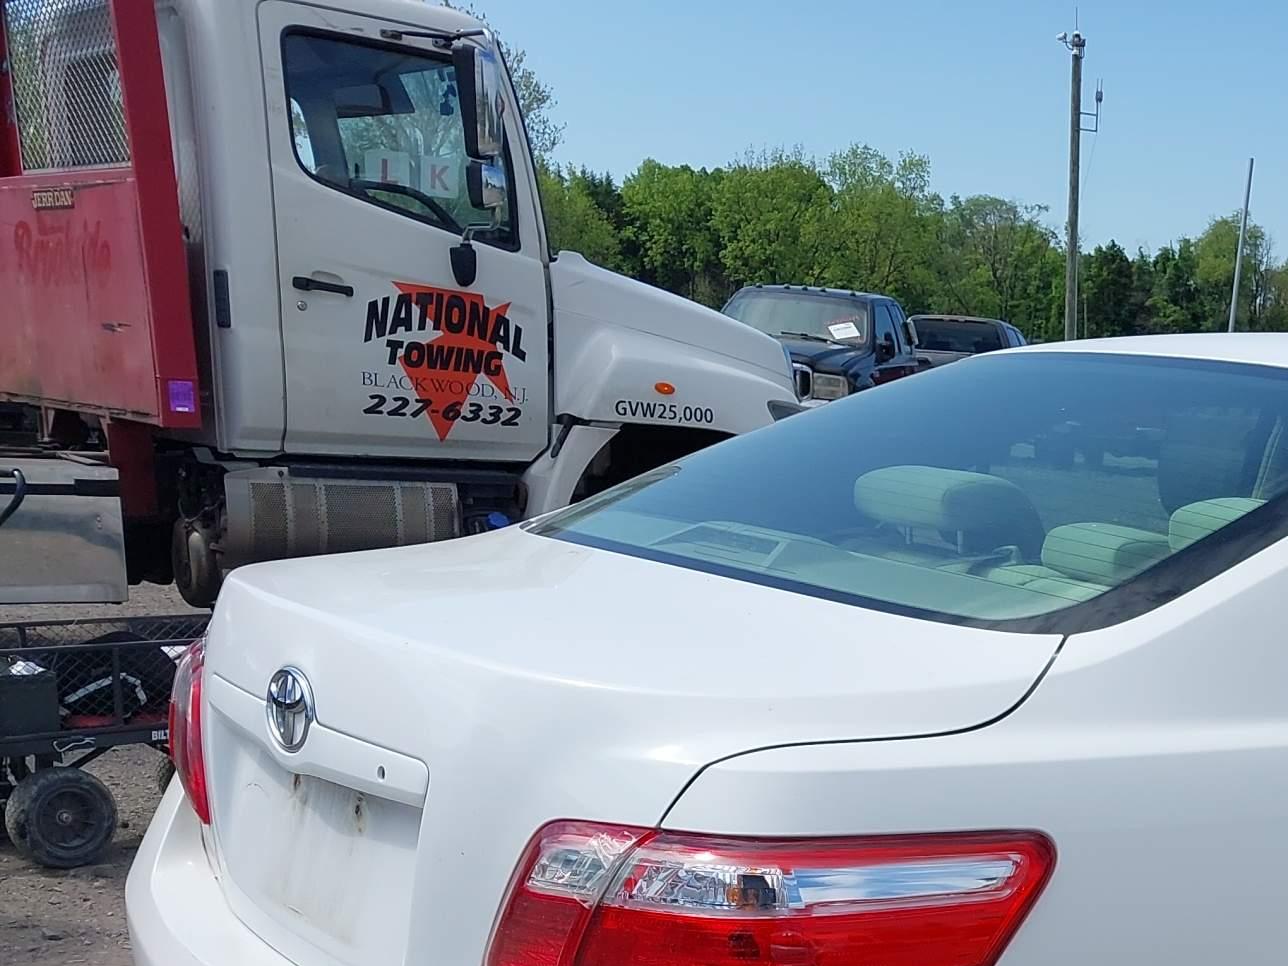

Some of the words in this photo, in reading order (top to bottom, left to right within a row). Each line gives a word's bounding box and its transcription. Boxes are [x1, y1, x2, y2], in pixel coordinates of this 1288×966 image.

[431, 164, 450, 191] K
[363, 292, 527, 363] NATIONAL
[386, 339, 504, 377] TOWING
[361, 371, 498, 400] BLACKWOOD,
[504, 386, 529, 405] N.J.
[362, 394, 522, 427] 227-6332
[615, 400, 714, 424] GVW25,000
